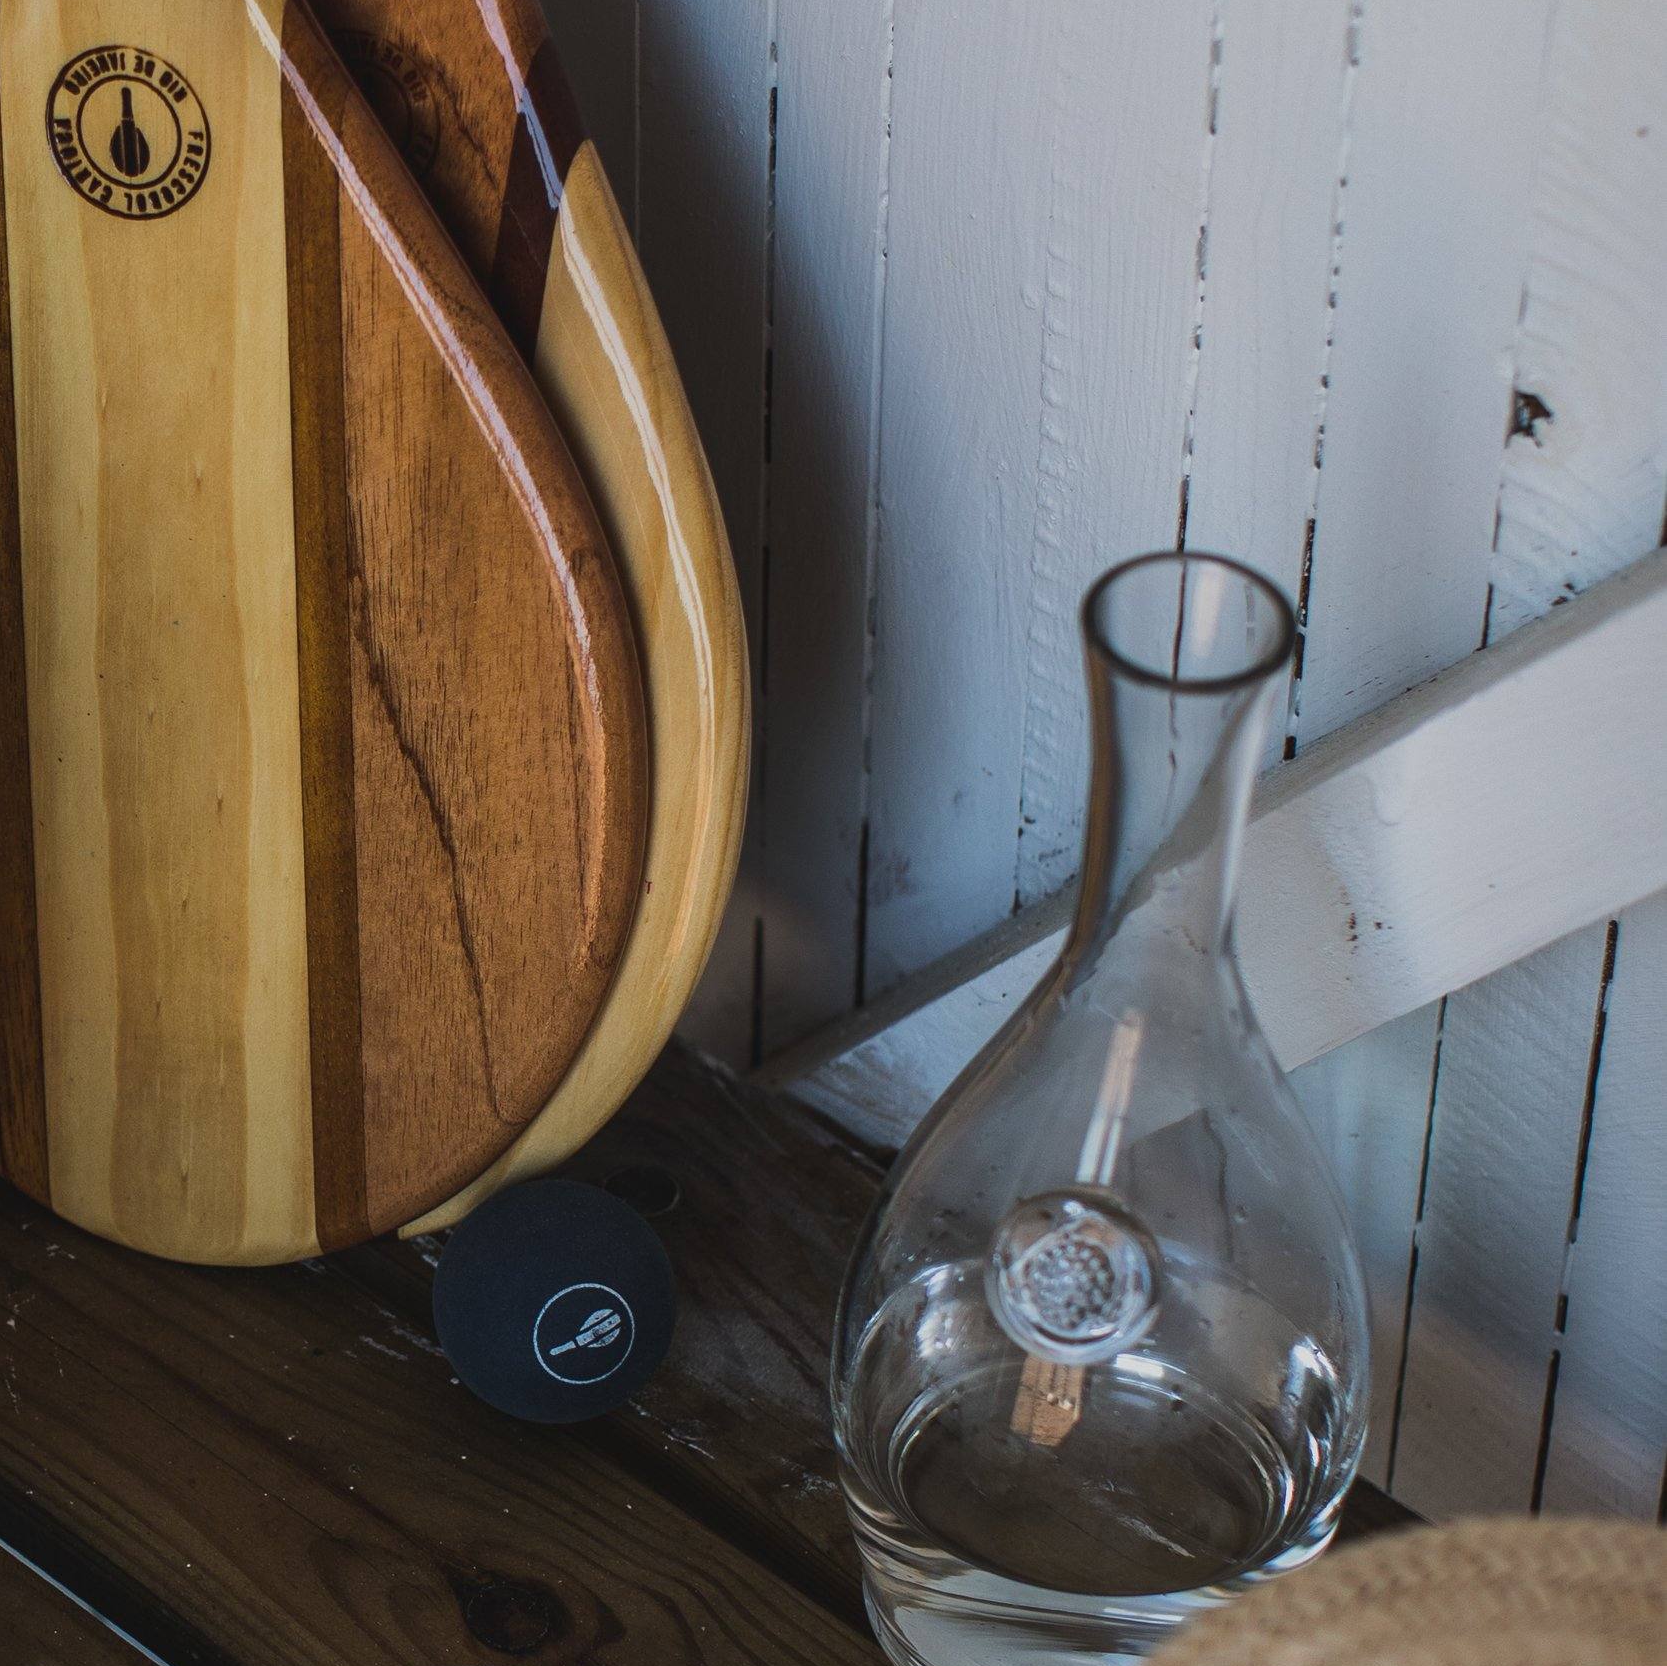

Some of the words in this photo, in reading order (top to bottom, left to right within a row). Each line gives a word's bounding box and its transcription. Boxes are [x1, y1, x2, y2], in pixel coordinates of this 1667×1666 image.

[63, 52, 126, 95] JANEIRO
[133, 55, 156, 78] DE
[159, 71, 188, 103] RIO
[124, 130, 205, 213] FRESCOBOL
